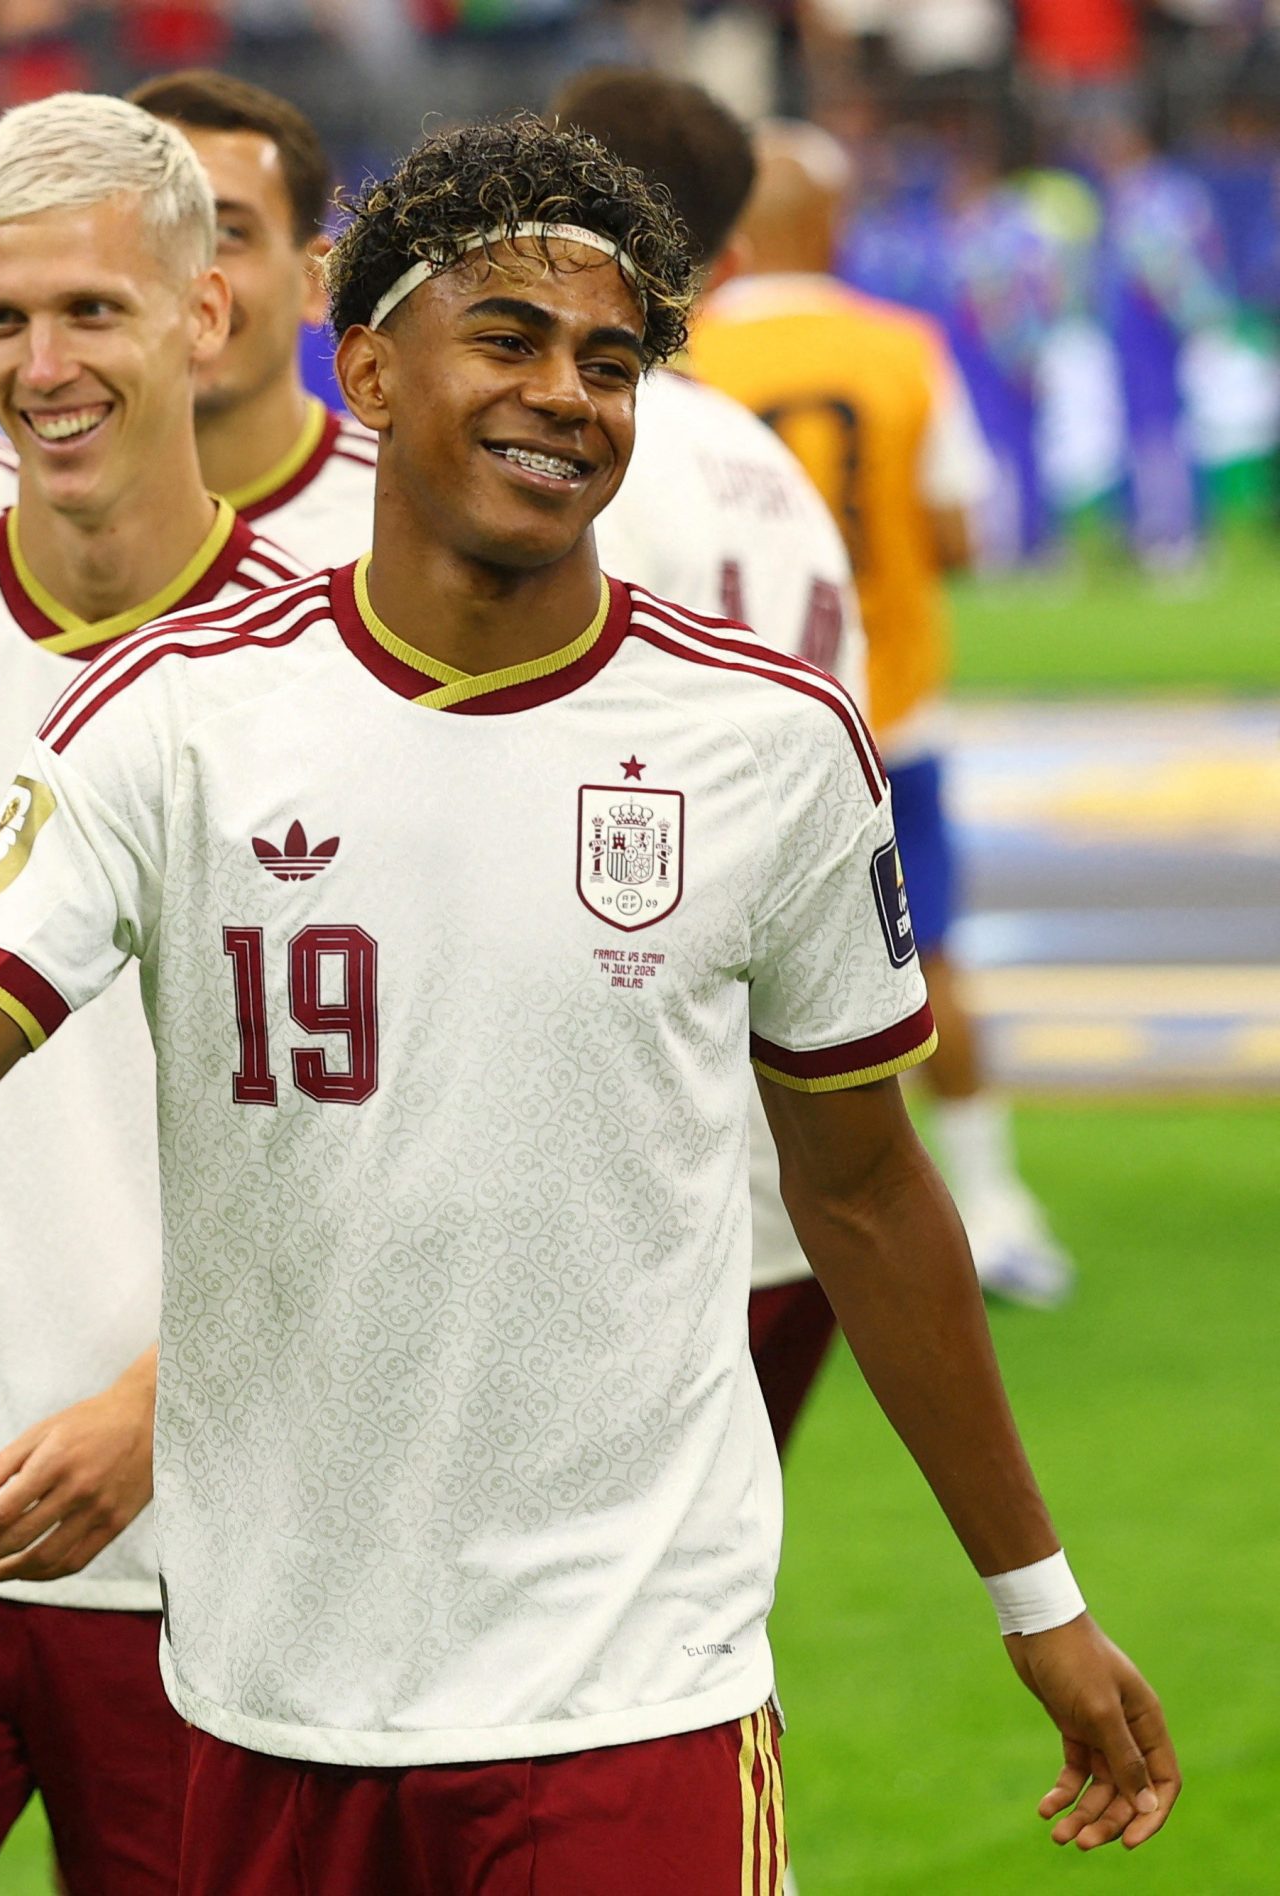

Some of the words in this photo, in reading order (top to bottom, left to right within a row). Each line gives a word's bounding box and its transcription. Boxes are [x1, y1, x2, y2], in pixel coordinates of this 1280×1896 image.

[593, 949, 626, 962] FRANCE
[628, 951, 639, 962] VS
[641, 952, 665, 964] SPAIN
[600, 962, 610, 973] 14
[611, 963, 632, 975] JULY
[634, 965, 656, 977] 2026
[611, 976, 644, 989] DALLAS
[223, 924, 378, 1106] 19
